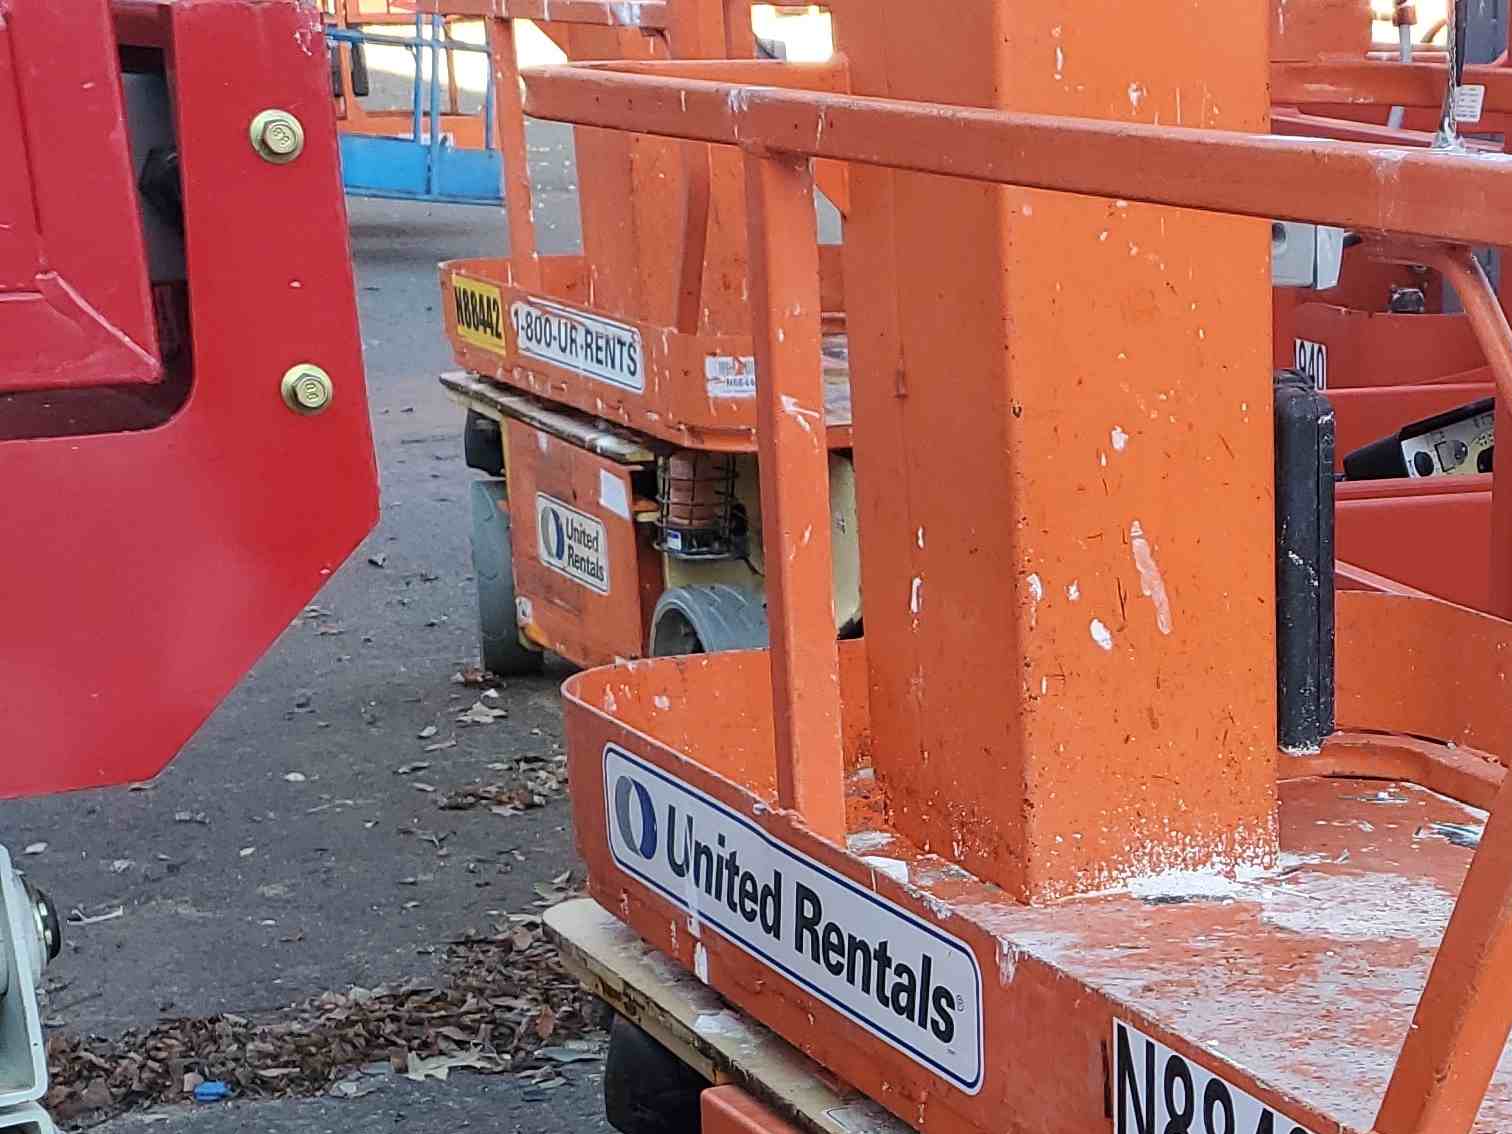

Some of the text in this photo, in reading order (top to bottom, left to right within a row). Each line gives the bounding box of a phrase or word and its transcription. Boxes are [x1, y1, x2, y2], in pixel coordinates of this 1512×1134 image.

[454, 286, 503, 340] N88442
[566, 516, 599, 552] United
[567, 544, 604, 581] Rentals
[667, 812, 956, 1045] United Rentals
